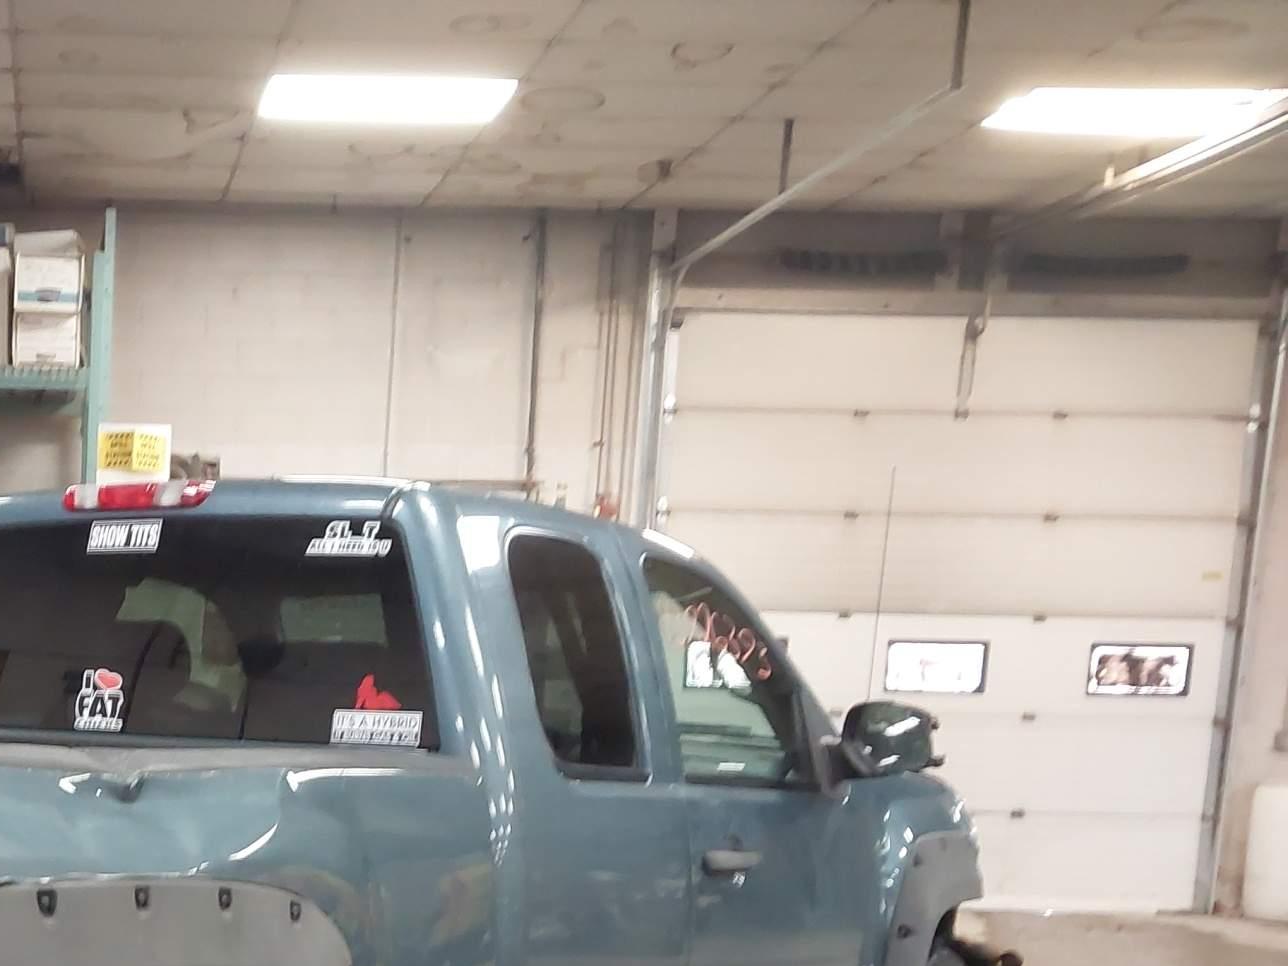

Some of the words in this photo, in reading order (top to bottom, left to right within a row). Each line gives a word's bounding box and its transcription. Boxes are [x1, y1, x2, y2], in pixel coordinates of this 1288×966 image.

[91, 525, 130, 548] SHOW
[130, 524, 159, 549] TITS
[78, 693, 120, 718] FAT
